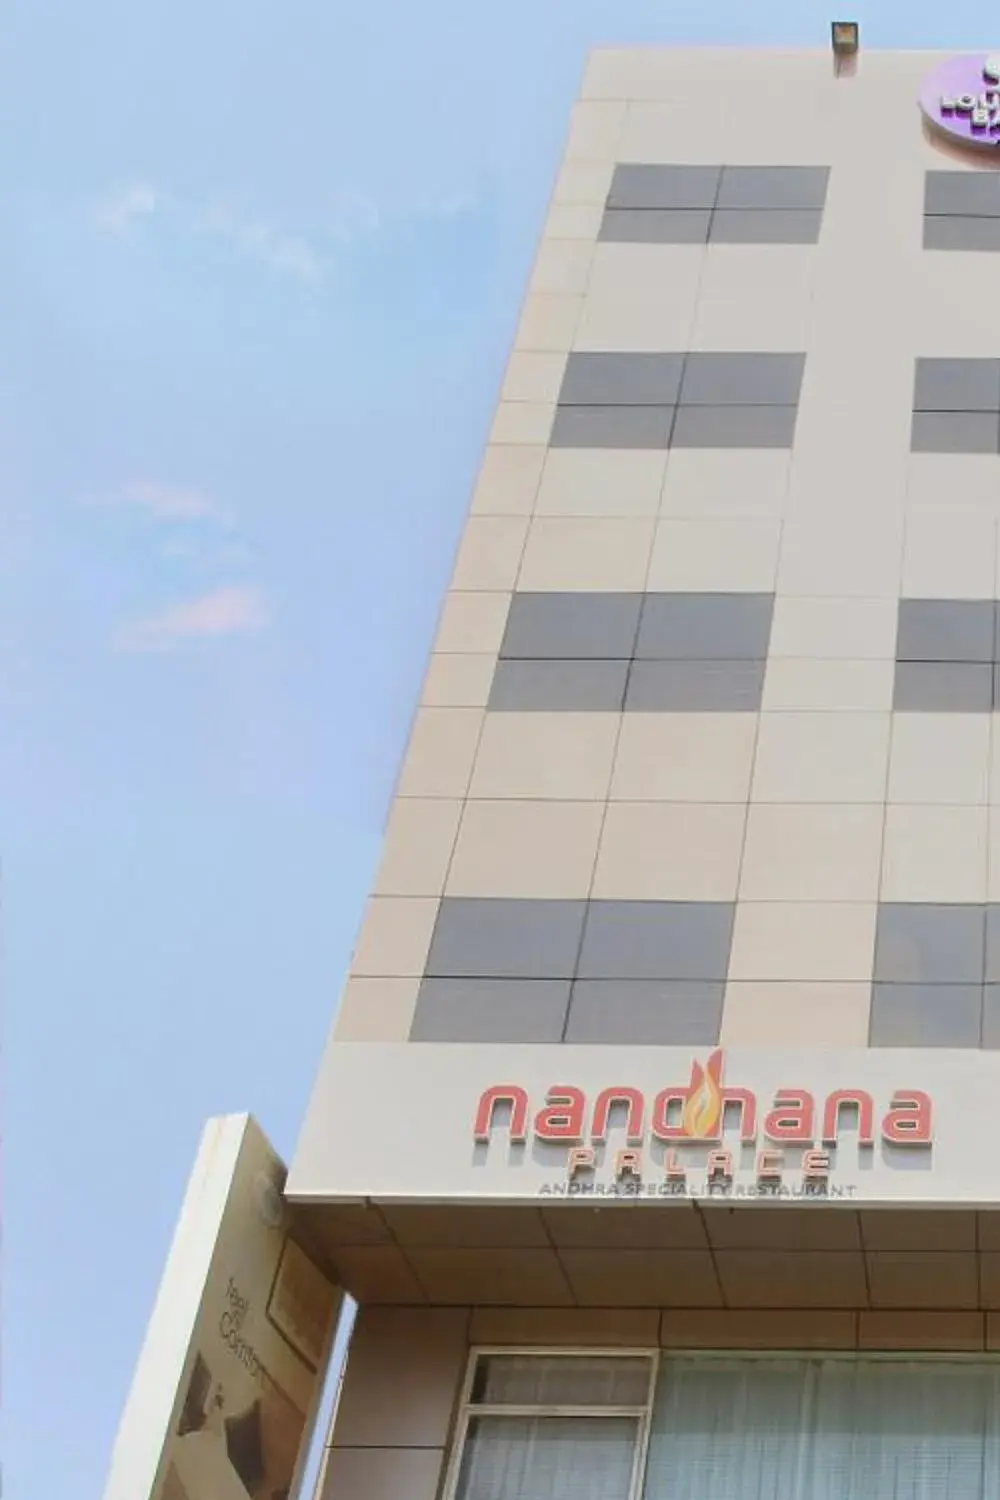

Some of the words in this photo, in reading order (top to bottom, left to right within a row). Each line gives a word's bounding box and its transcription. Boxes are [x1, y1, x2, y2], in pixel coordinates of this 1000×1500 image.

[474, 1048, 933, 1146] nandhana
[567, 1147, 831, 1180] PALACE
[538, 1182, 619, 1197] ANDHRA
[623, 1182, 730, 1197] SPECIALITY
[736, 1182, 858, 1198] RESTAURANT
